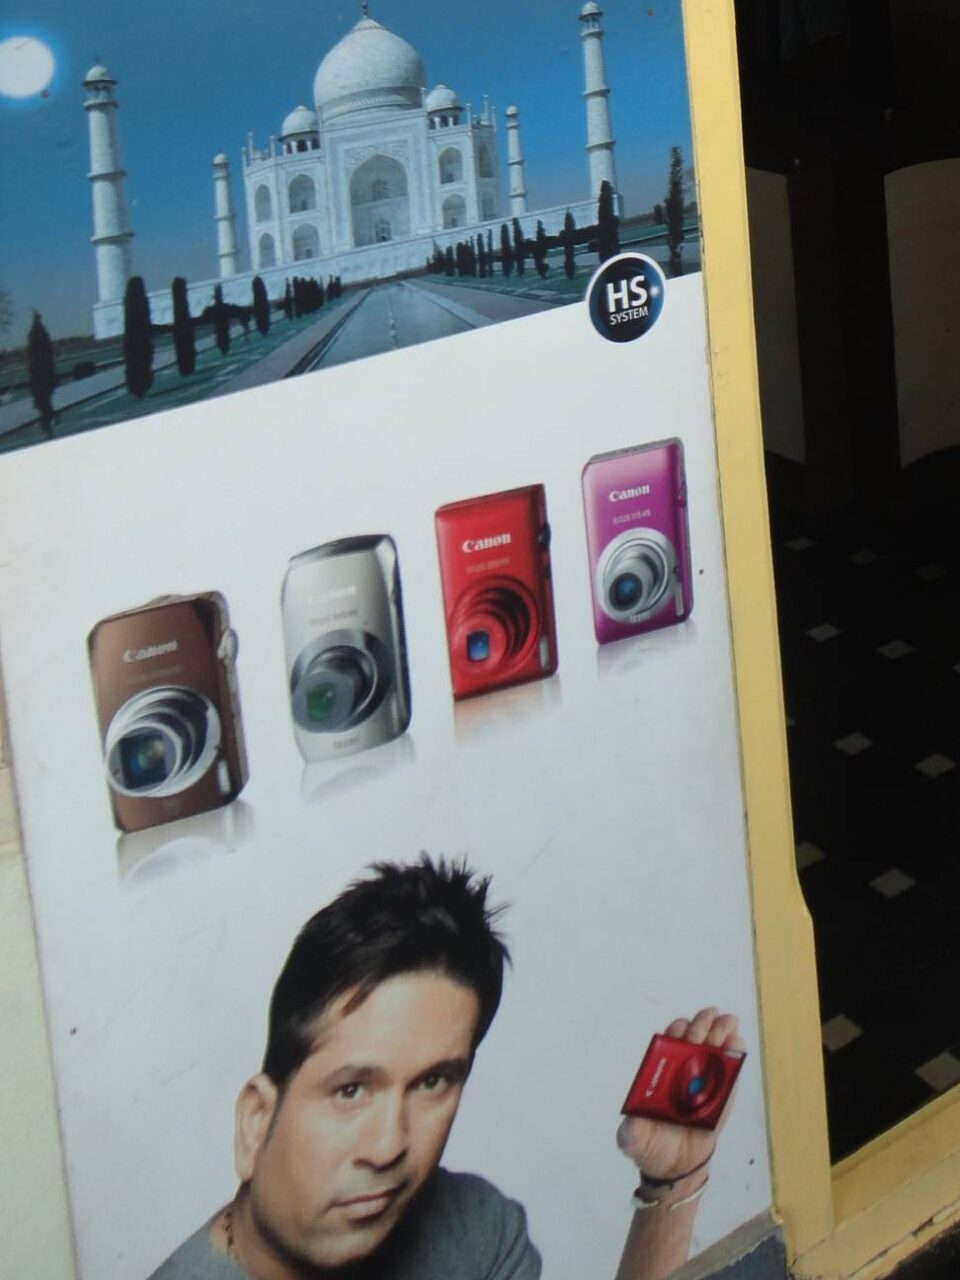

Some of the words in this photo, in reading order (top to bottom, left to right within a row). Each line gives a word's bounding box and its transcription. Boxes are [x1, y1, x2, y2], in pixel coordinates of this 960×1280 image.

[606, 275, 648, 313] HS
[609, 306, 649, 325] SYSTEM
[609, 484, 650, 503] Canon
[462, 533, 512, 553] Canon
[122, 639, 178, 663] Canon
